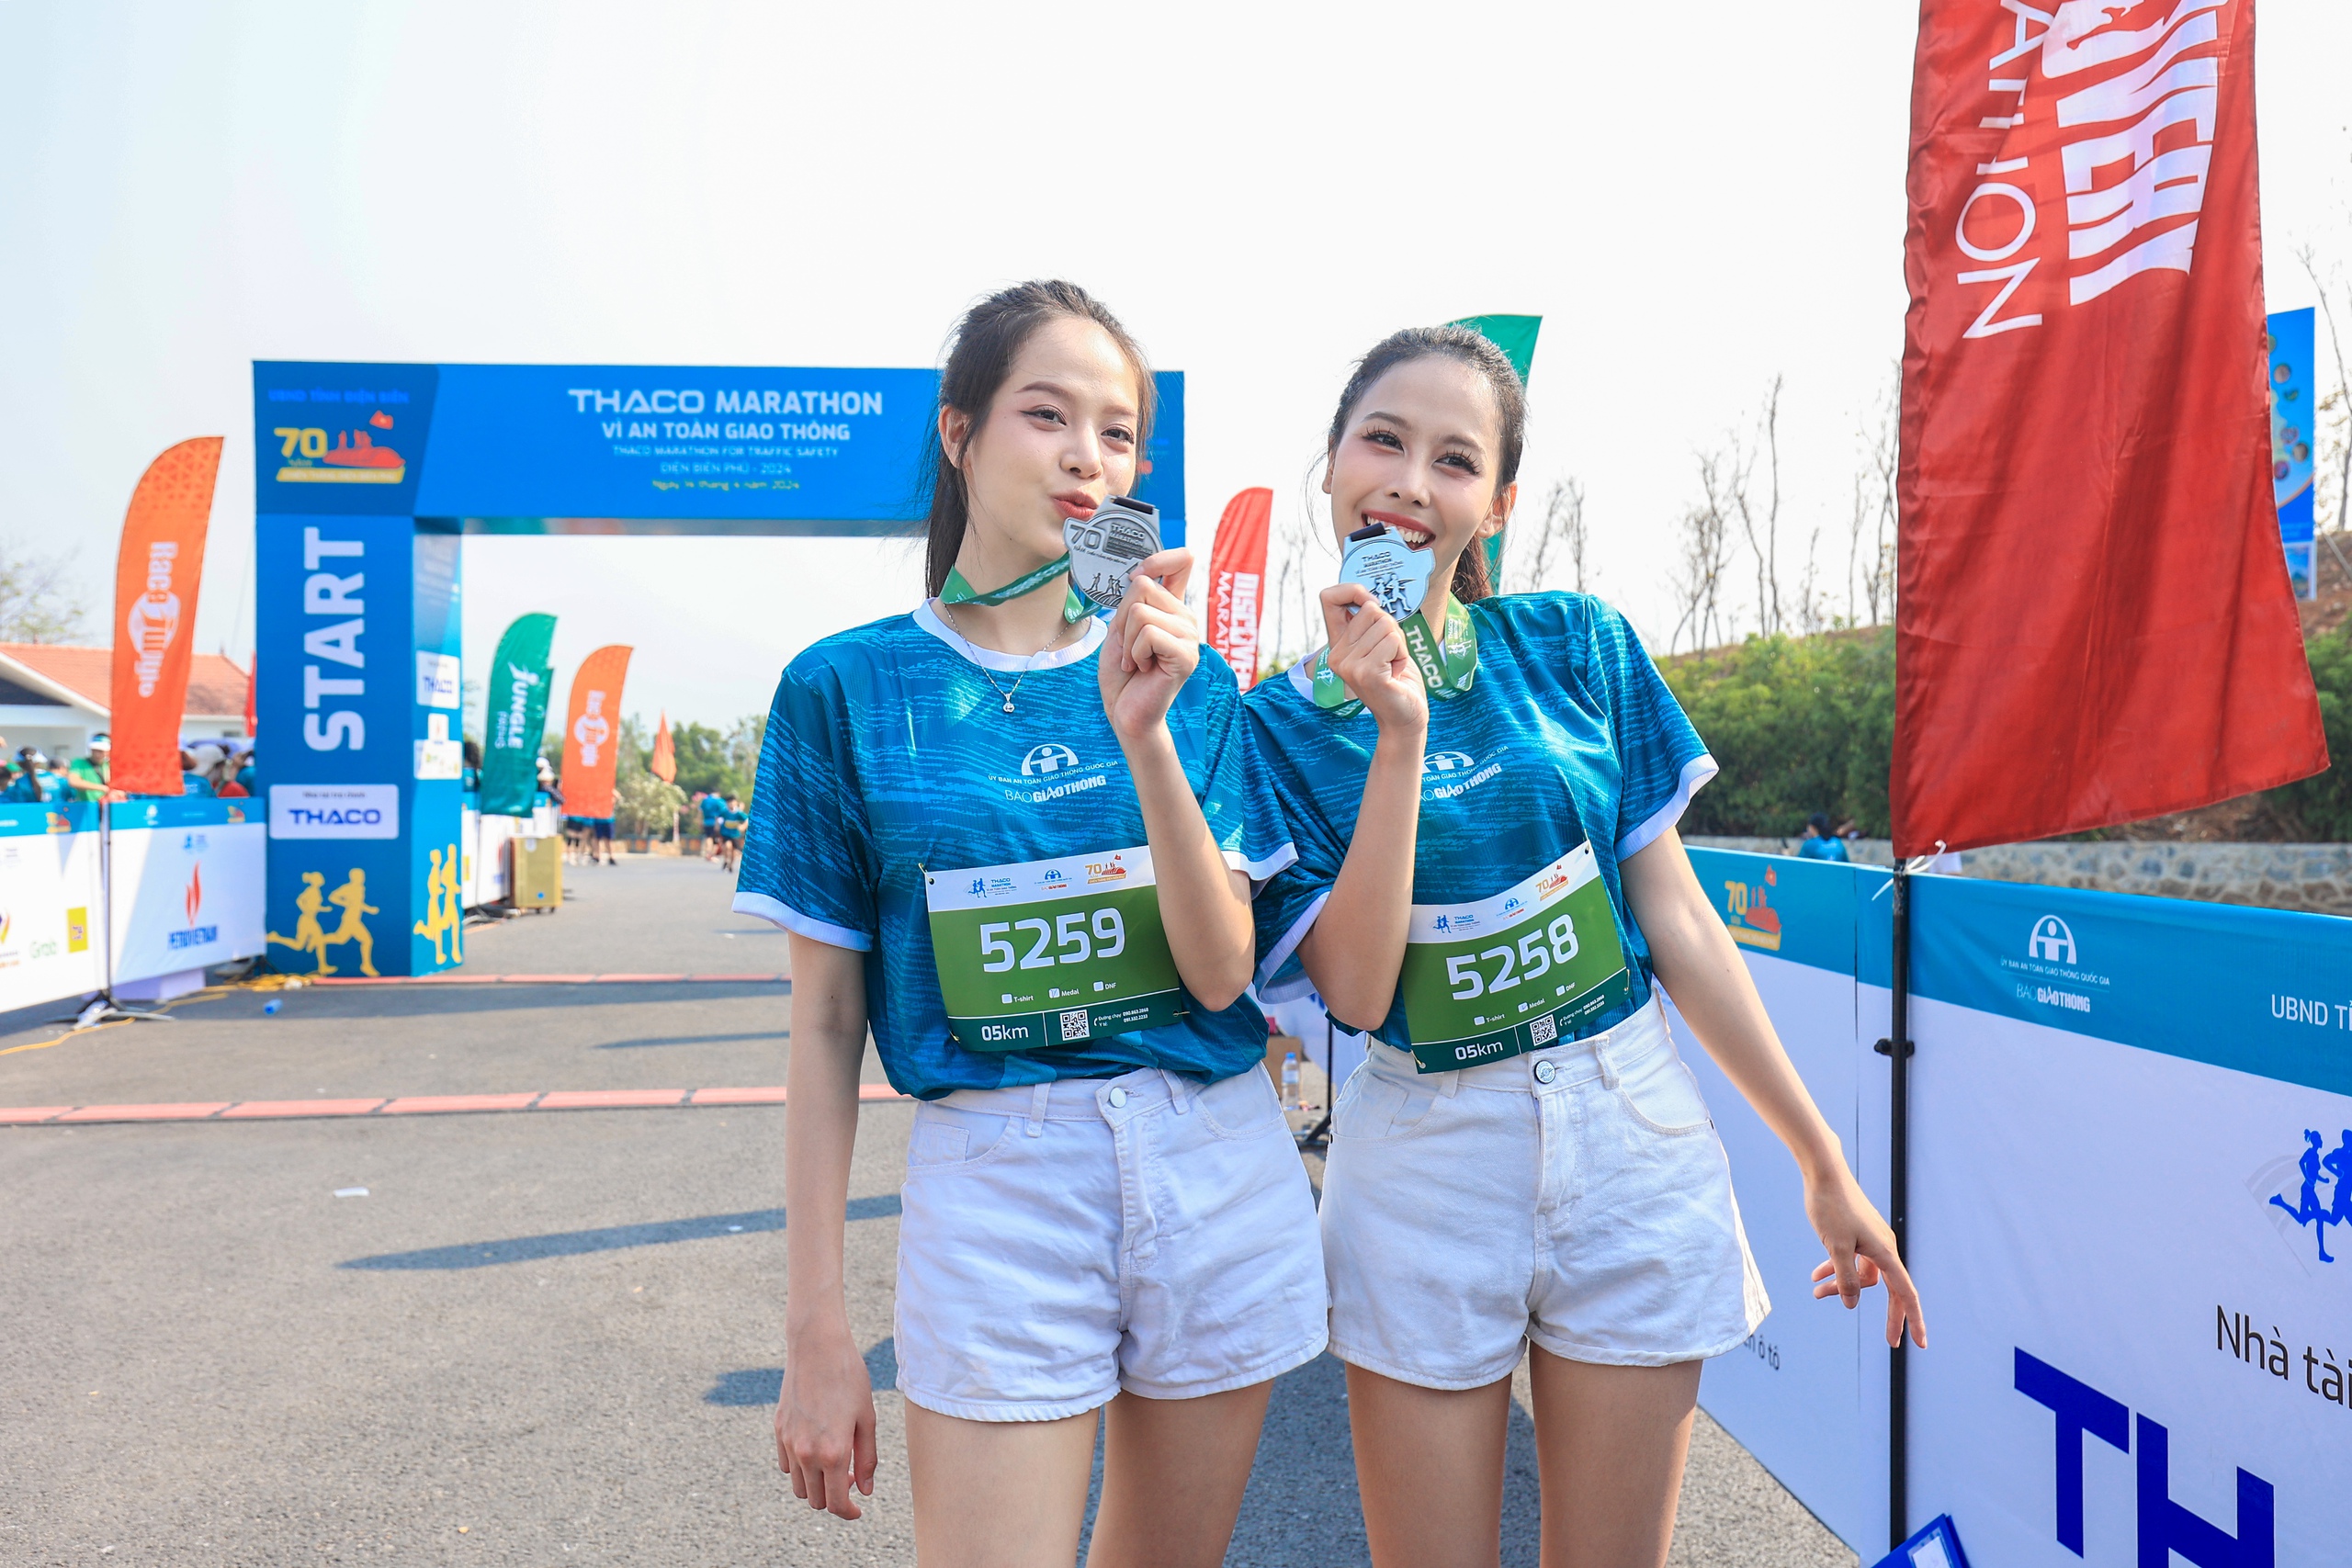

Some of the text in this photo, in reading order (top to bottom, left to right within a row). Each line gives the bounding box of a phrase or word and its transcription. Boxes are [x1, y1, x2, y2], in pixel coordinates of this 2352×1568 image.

[568, 389, 882, 415] THACO MARATHON
[602, 417, 850, 441] VÌ AN TOÀN GIAO THÔNG
[274, 427, 328, 457] 70
[1069, 525, 1101, 549] 70
[1111, 524, 1146, 539] THACO
[303, 526, 365, 751] START
[1229, 571, 1260, 695] DISCOVER
[1407, 626, 1443, 688] THACO
[1043, 773, 1059, 783] GIAO
[288, 808, 381, 825] THACO
[1085, 863, 1102, 874] 70
[1535, 878, 1550, 894] 70
[1724, 880, 1747, 915] 70
[979, 908, 1125, 972] 5259
[1445, 914, 1579, 1000] 5258
[1104, 982, 1116, 990] DNF
[2044, 965, 2058, 976] GIAO
[2059, 968, 2079, 980] THÔNG
[2099, 976, 2109, 986] GIA
[1061, 988, 1080, 998] Medal
[1565, 982, 1576, 992] DNF
[1013, 994, 1035, 1003] T-shirt
[1529, 998, 1545, 1010] Medal
[1486, 1013, 1505, 1023] T-shirt
[2271, 994, 2328, 1026] UBND
[981, 1024, 1029, 1042] 05km
[1454, 1040, 1504, 1061] 05km
[1768, 1343, 1780, 1371] tô
[2217, 1304, 2352, 1410] Nhà tài
[2015, 1346, 2275, 1568] TH
